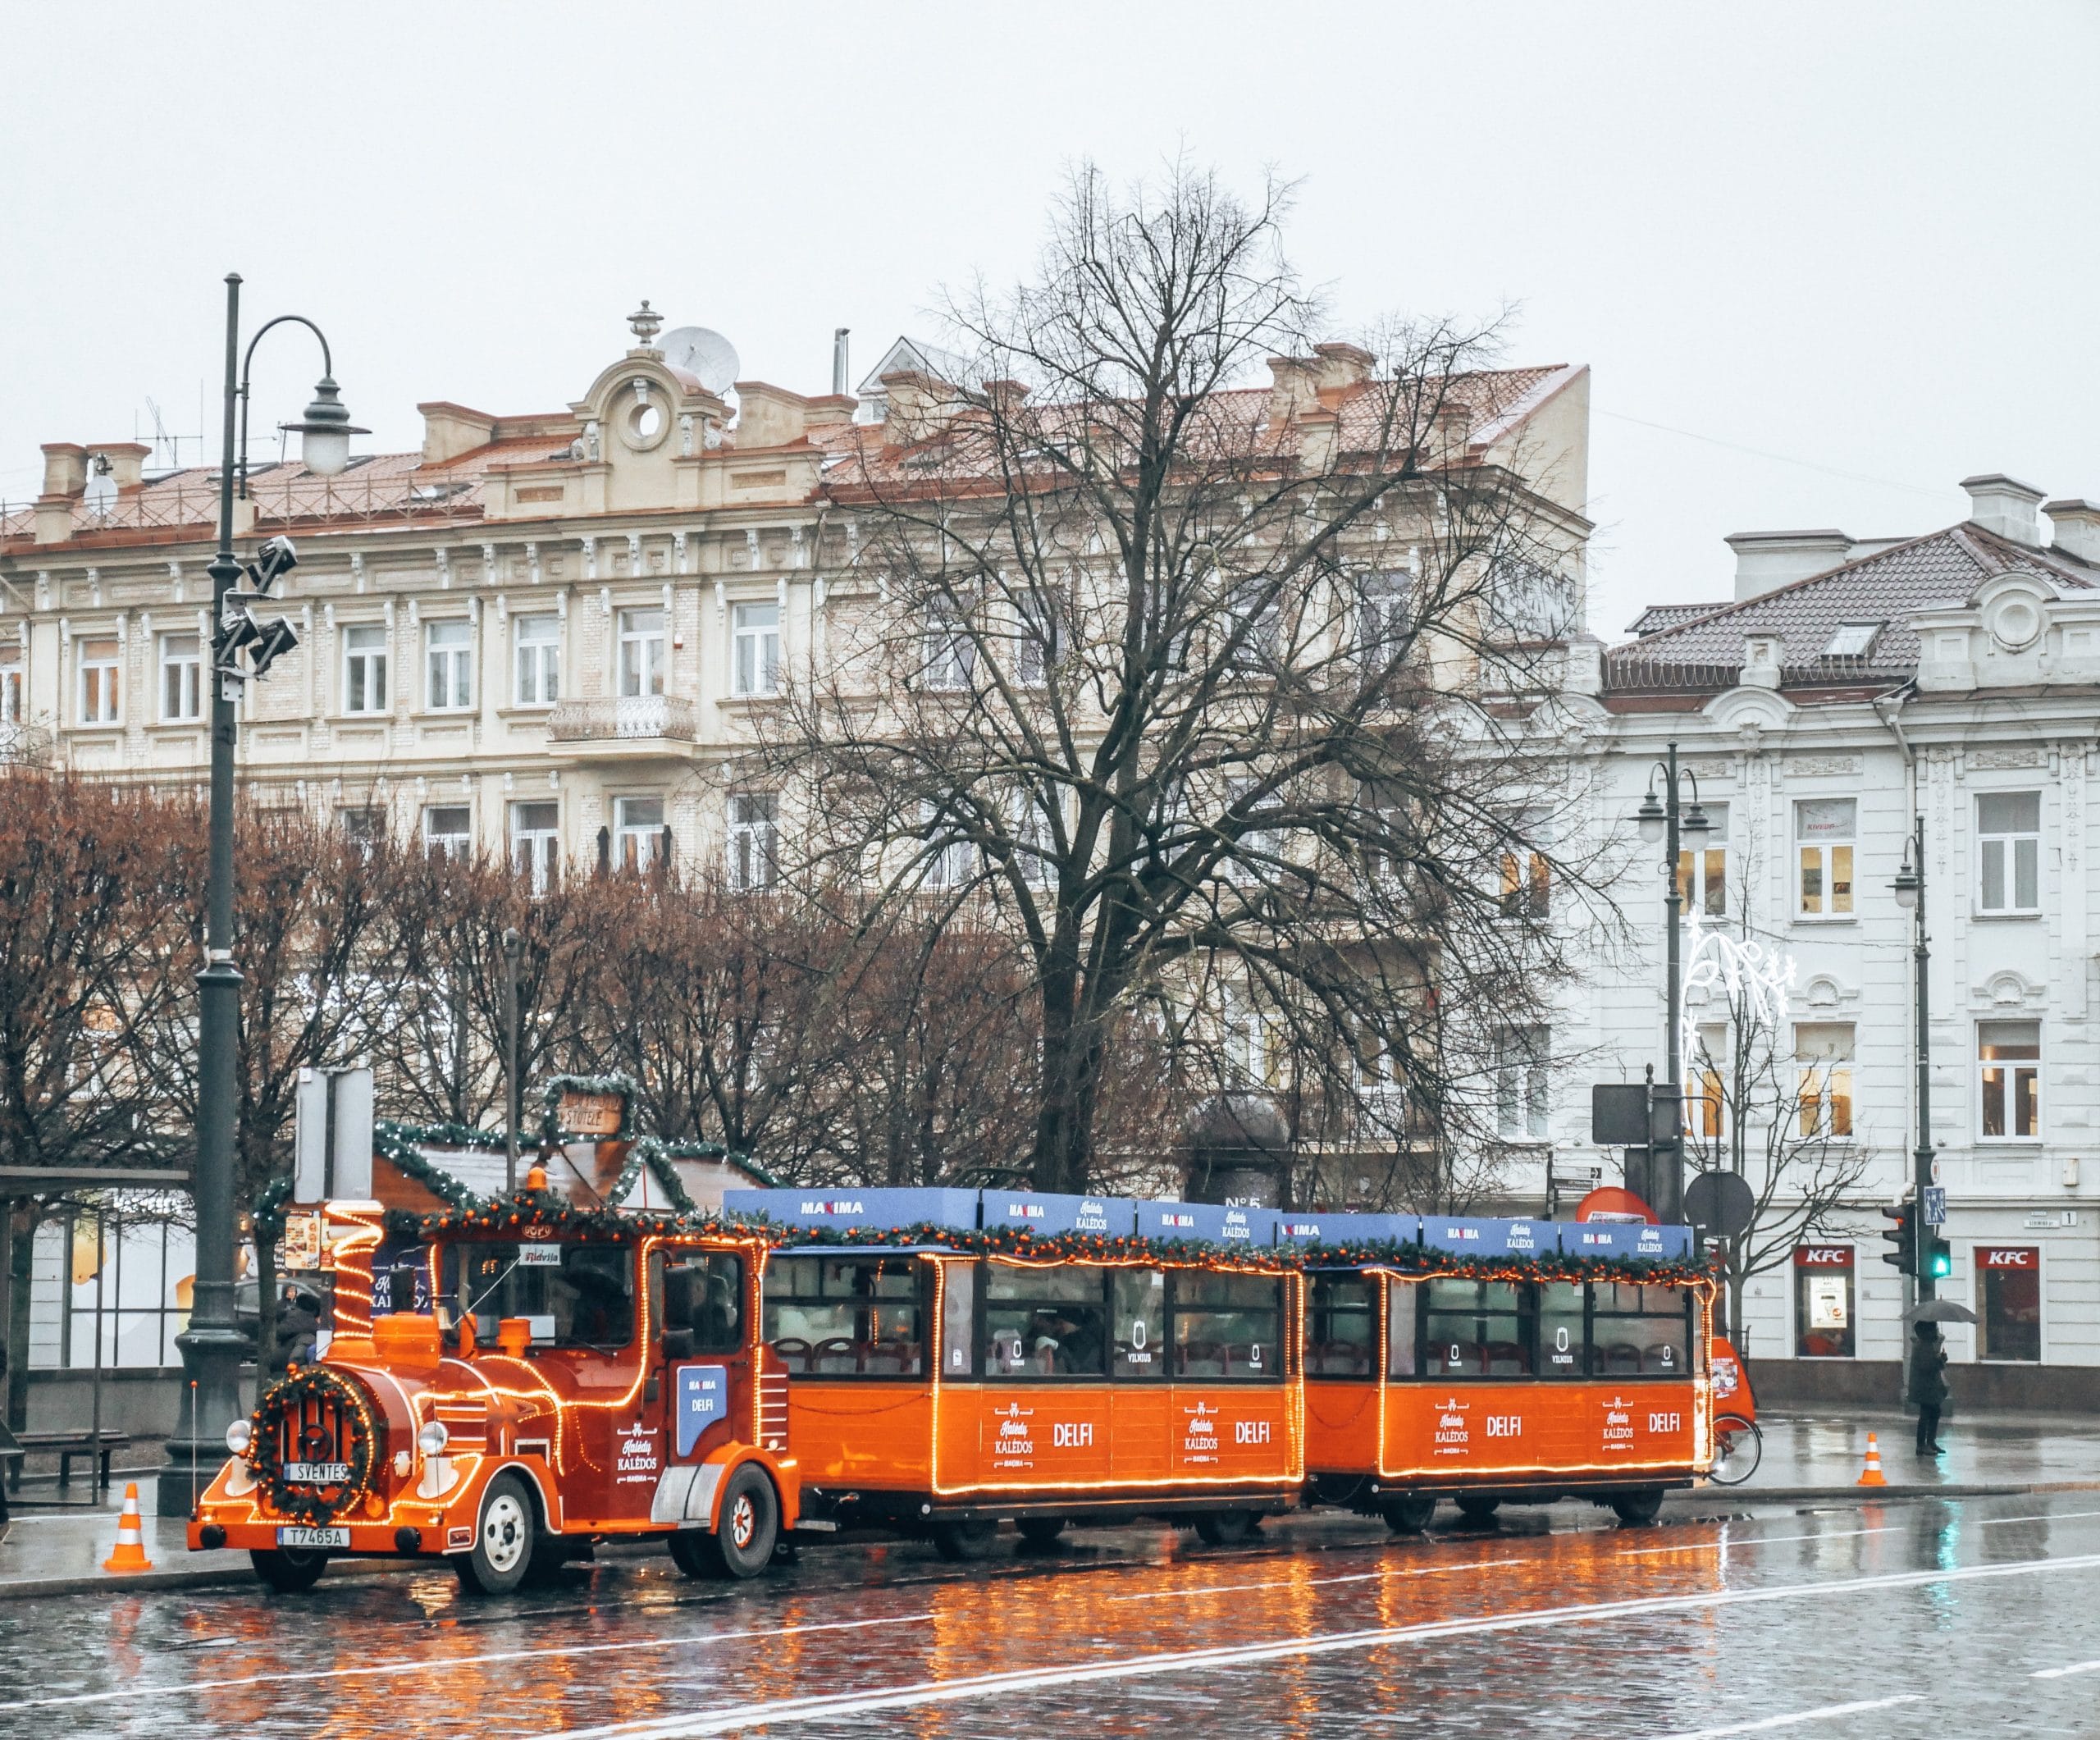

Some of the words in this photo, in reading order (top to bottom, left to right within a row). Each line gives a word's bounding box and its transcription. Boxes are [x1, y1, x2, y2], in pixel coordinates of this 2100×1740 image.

[801, 1200, 863, 1215] MAXIMA
[1009, 1204, 1044, 1217] MAXIMA
[1162, 1213, 1194, 1227] MAXIMA
[2066, 1213, 2071, 1224] 1
[1447, 1227, 1479, 1239] MAXIMA
[1583, 1233, 1612, 1244] MAXIMA
[1806, 1249, 1845, 1263] KFC
[1988, 1251, 2029, 1264] KFC
[1128, 1353, 1151, 1363] VILNIUS
[1552, 1355, 1573, 1363] VILNIUS
[689, 1381, 716, 1391] MAXIMA
[692, 1399, 714, 1412] DELFI
[1486, 1416, 1522, 1436] DELFI
[1649, 1413, 1680, 1432] DELFI
[1053, 1423, 1093, 1446] DELFI
[1235, 1422, 1270, 1444] DELFI
[298, 1464, 347, 1480] SVENTES
[290, 1528, 343, 1545] T7465A
